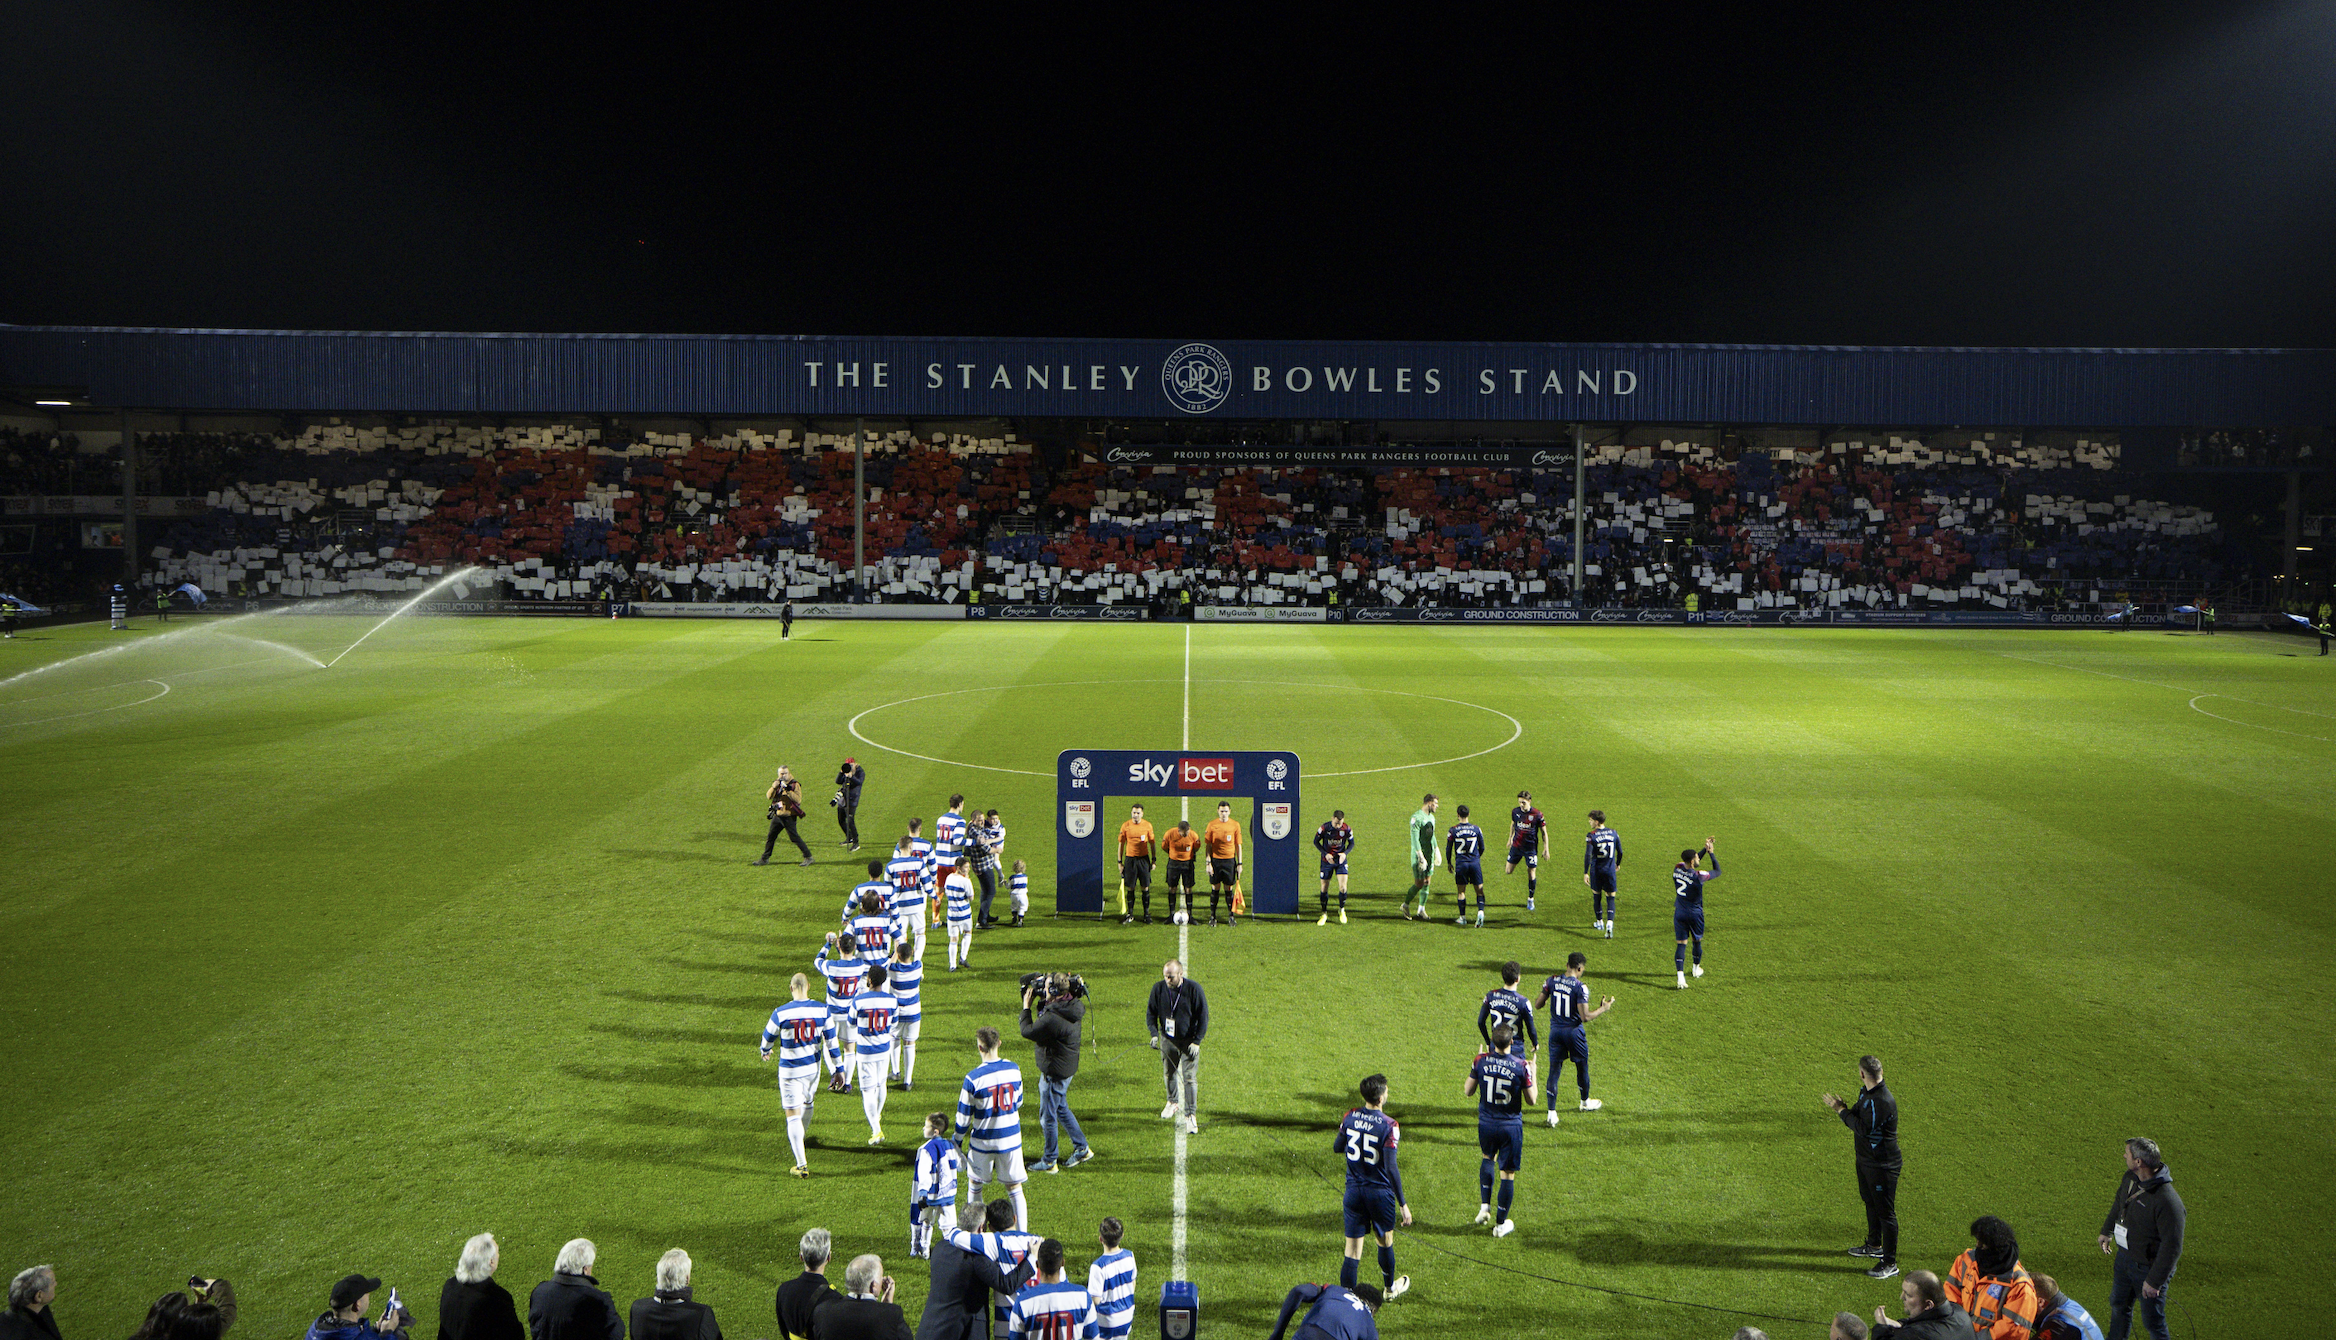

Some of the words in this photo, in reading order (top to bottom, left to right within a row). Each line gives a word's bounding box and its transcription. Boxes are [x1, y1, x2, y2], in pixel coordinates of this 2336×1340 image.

[1165, 351, 1185, 381] QUEENS
[1185, 346, 1205, 354] PARK
[1206, 349, 1229, 381] RANGERS
[804, 361, 888, 388] THE
[927, 363, 1140, 391] STANLEY
[1252, 366, 1441, 395] BOWLES
[1479, 368, 1637, 395] STAND
[1186, 403, 1207, 411] 1882
[1106, 446, 1153, 463] Convivia
[1173, 451, 1210, 460] PROUD
[1215, 451, 1271, 460] SPONSORS
[1276, 452, 1290, 460] OF
[1294, 452, 1336, 461] QUEENS
[1341, 452, 1367, 460] PARK
[1371, 452, 1420, 461] RANGERS
[1425, 453, 1478, 461] FOOTBALL
[1483, 453, 1510, 461] CLUB
[1531, 450, 1575, 465] Convivia
[245, 601, 260, 611] P6
[413, 602, 484, 612] ONSTRUCTION
[611, 604, 625, 613] P7
[970, 606, 985, 616] P8
[1000, 605, 1038, 617] Convivia
[1050, 606, 1087, 617] Convivia
[1100, 606, 1138, 618] Convivia
[1218, 609, 1257, 618] MyGuava
[1279, 609, 1317, 618] MyGuava
[1328, 610, 1342, 620] P10
[1355, 608, 1393, 620] Convivia
[1418, 608, 1455, 620] Convivia
[1464, 610, 1505, 620] GROUND
[1506, 610, 1579, 621] CONSTRUCTION
[1687, 611, 1704, 622] P11
[2051, 614, 2091, 623] GROUND
[1129, 758, 1175, 787] sky
[1184, 760, 1228, 783] bet
[1072, 779, 1090, 788] EFL
[1268, 781, 1286, 791] EFL
[938, 823, 951, 841] 10
[1455, 836, 1478, 854] 27
[1596, 842, 1615, 859] 31
[897, 870, 916, 889] 10
[1676, 878, 1688, 897] 2
[862, 926, 884, 948] 10
[835, 976, 859, 997] 10
[1490, 999, 1520, 1014] JOHNSTON
[1553, 990, 1571, 1018] 11
[864, 1008, 889, 1033] 10
[790, 1018, 816, 1044] 10
[1483, 1065, 1516, 1080] PIETERS
[987, 1082, 1015, 1113] 10
[1483, 1075, 1512, 1105] 15
[1354, 1119, 1374, 1132] OKAY
[1346, 1127, 1380, 1166] 35
[1035, 1311, 1074, 1340] 10
